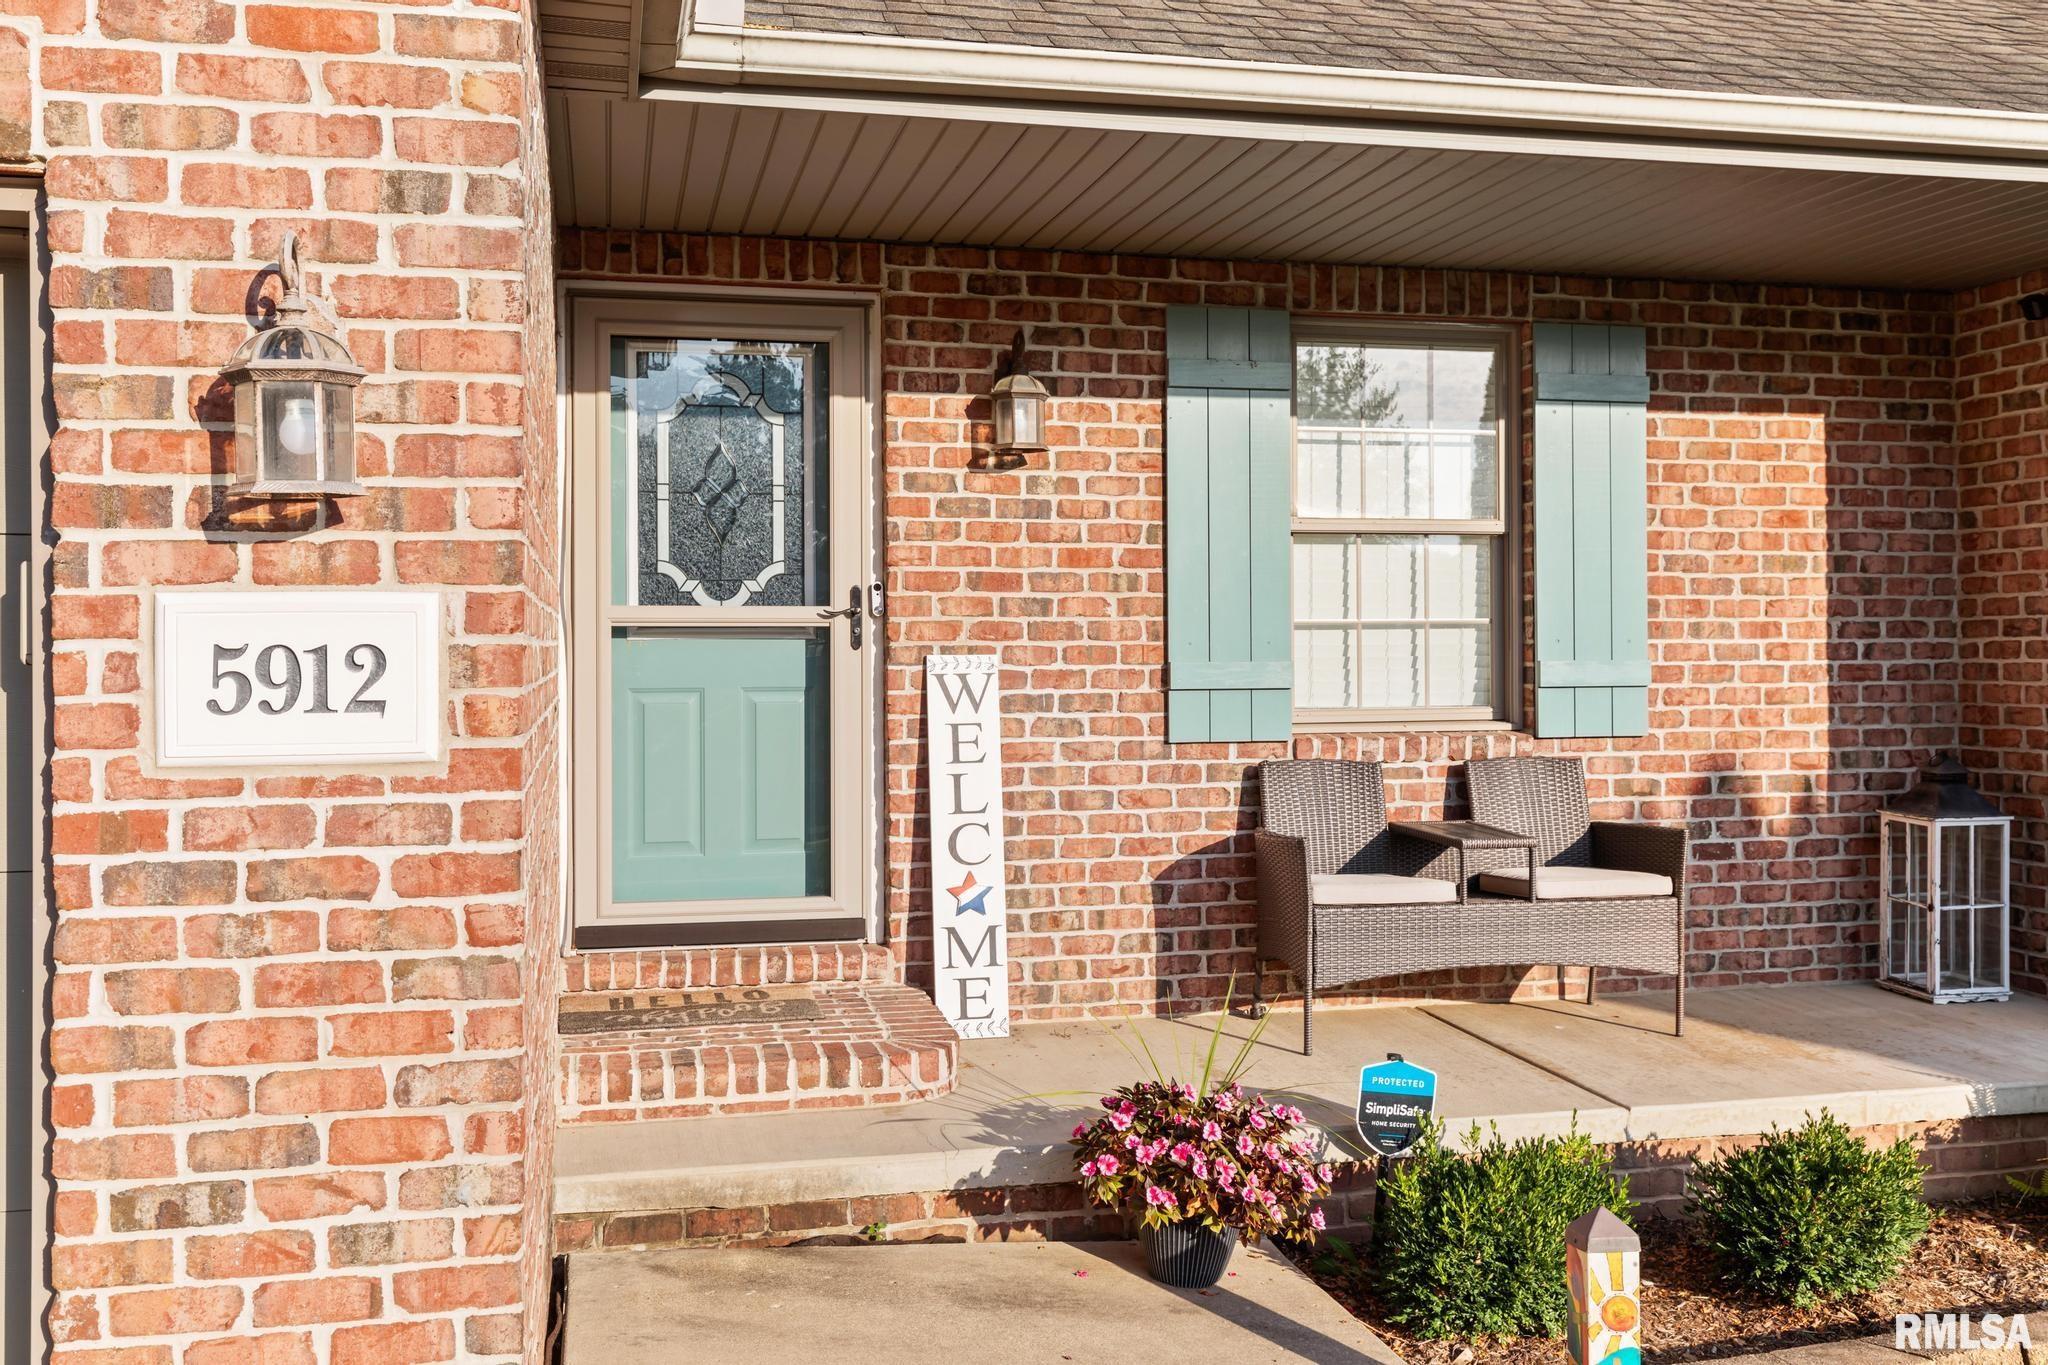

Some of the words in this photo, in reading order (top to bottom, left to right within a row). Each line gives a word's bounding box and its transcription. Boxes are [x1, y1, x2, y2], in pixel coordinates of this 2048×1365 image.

[206, 643, 387, 719] 5912
[609, 989, 770, 1010] HELLO
[1371, 1076, 1425, 1088] PROTECTED
[1365, 1101, 1425, 1117] SimpliSafe
[1389, 1121, 1416, 1129] SECURITY
